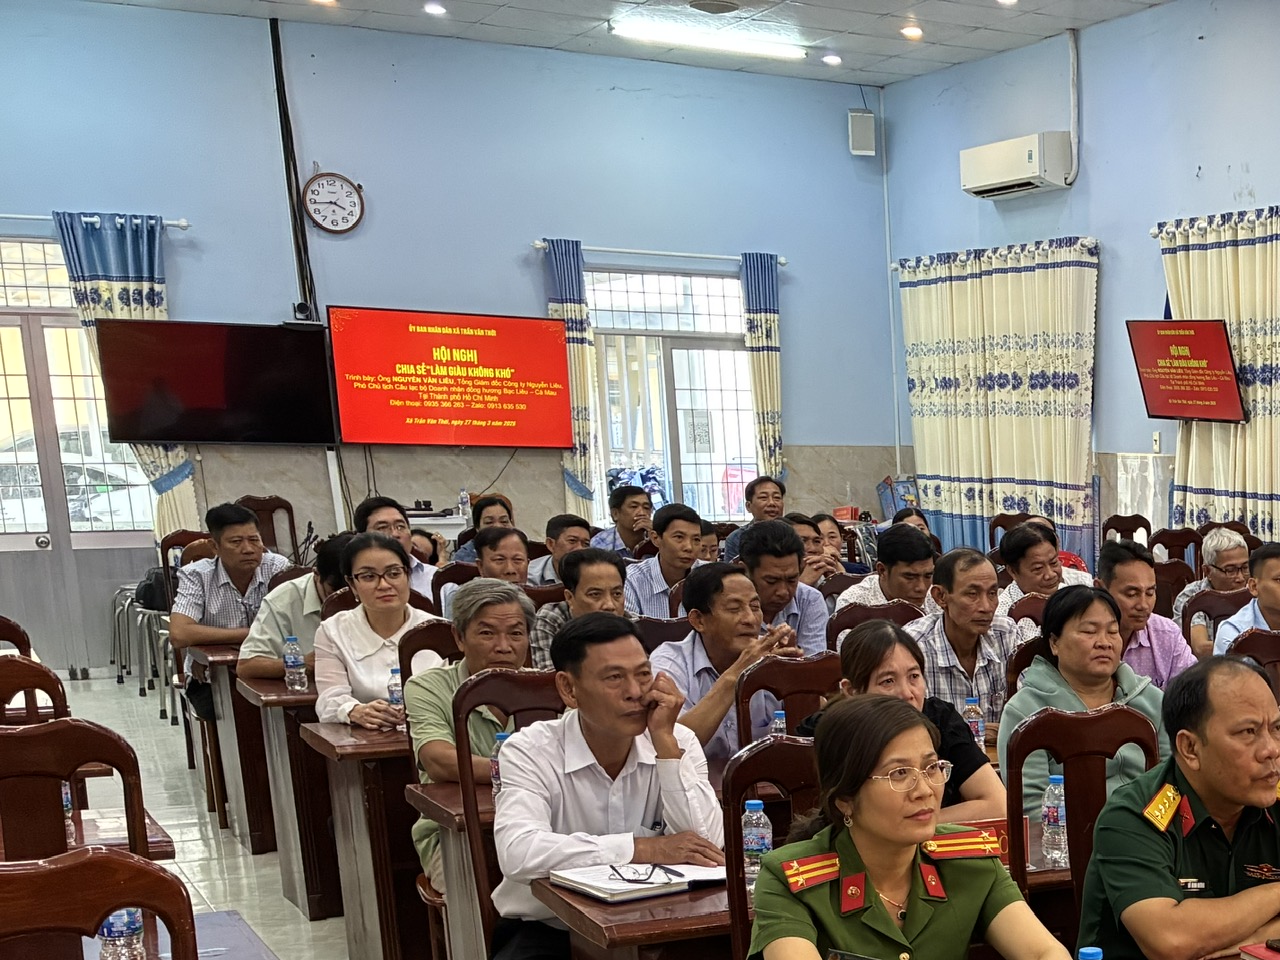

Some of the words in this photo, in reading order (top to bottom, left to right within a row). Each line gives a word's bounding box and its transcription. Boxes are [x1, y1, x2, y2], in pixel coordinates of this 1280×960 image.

[331, 219, 338, 227] 6
[433, 346, 451, 363] HỘI
[453, 349, 477, 364] NGHỊ
[396, 364, 415, 374] CHIA
[449, 366, 467, 376] GIÀU
[468, 366, 494, 378] KHÔNG
